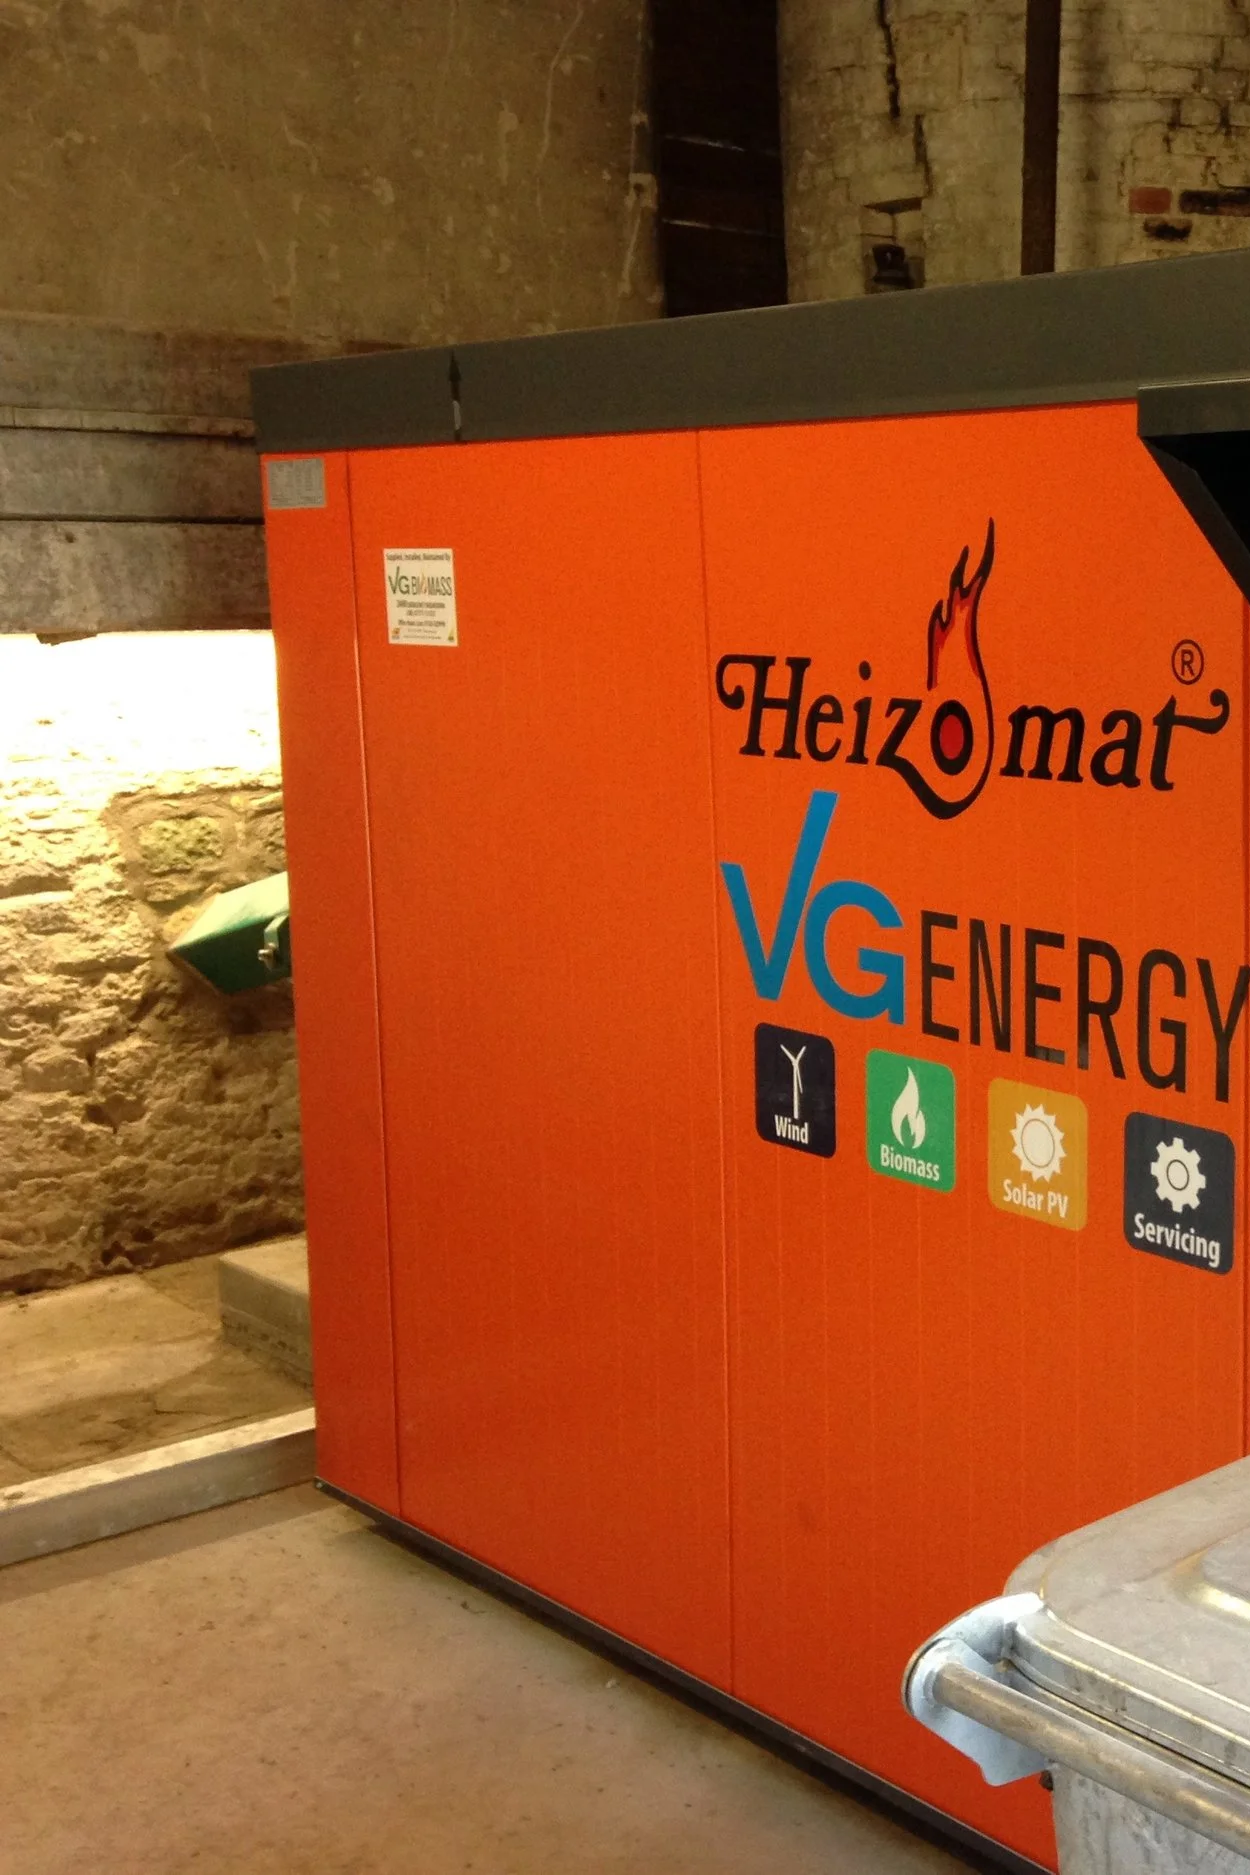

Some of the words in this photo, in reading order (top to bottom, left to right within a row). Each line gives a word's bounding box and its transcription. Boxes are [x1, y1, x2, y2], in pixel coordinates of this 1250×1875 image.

[715, 654, 1230, 820] Heizomat
[719, 790, 905, 1025] VG
[774, 1115, 809, 1145] Wind
[879, 1145, 940, 1183] Biomass
[1002, 1179, 1042, 1211] Solar
[1045, 1191, 1069, 1219] PV
[1133, 1212, 1221, 1268] Servicing
